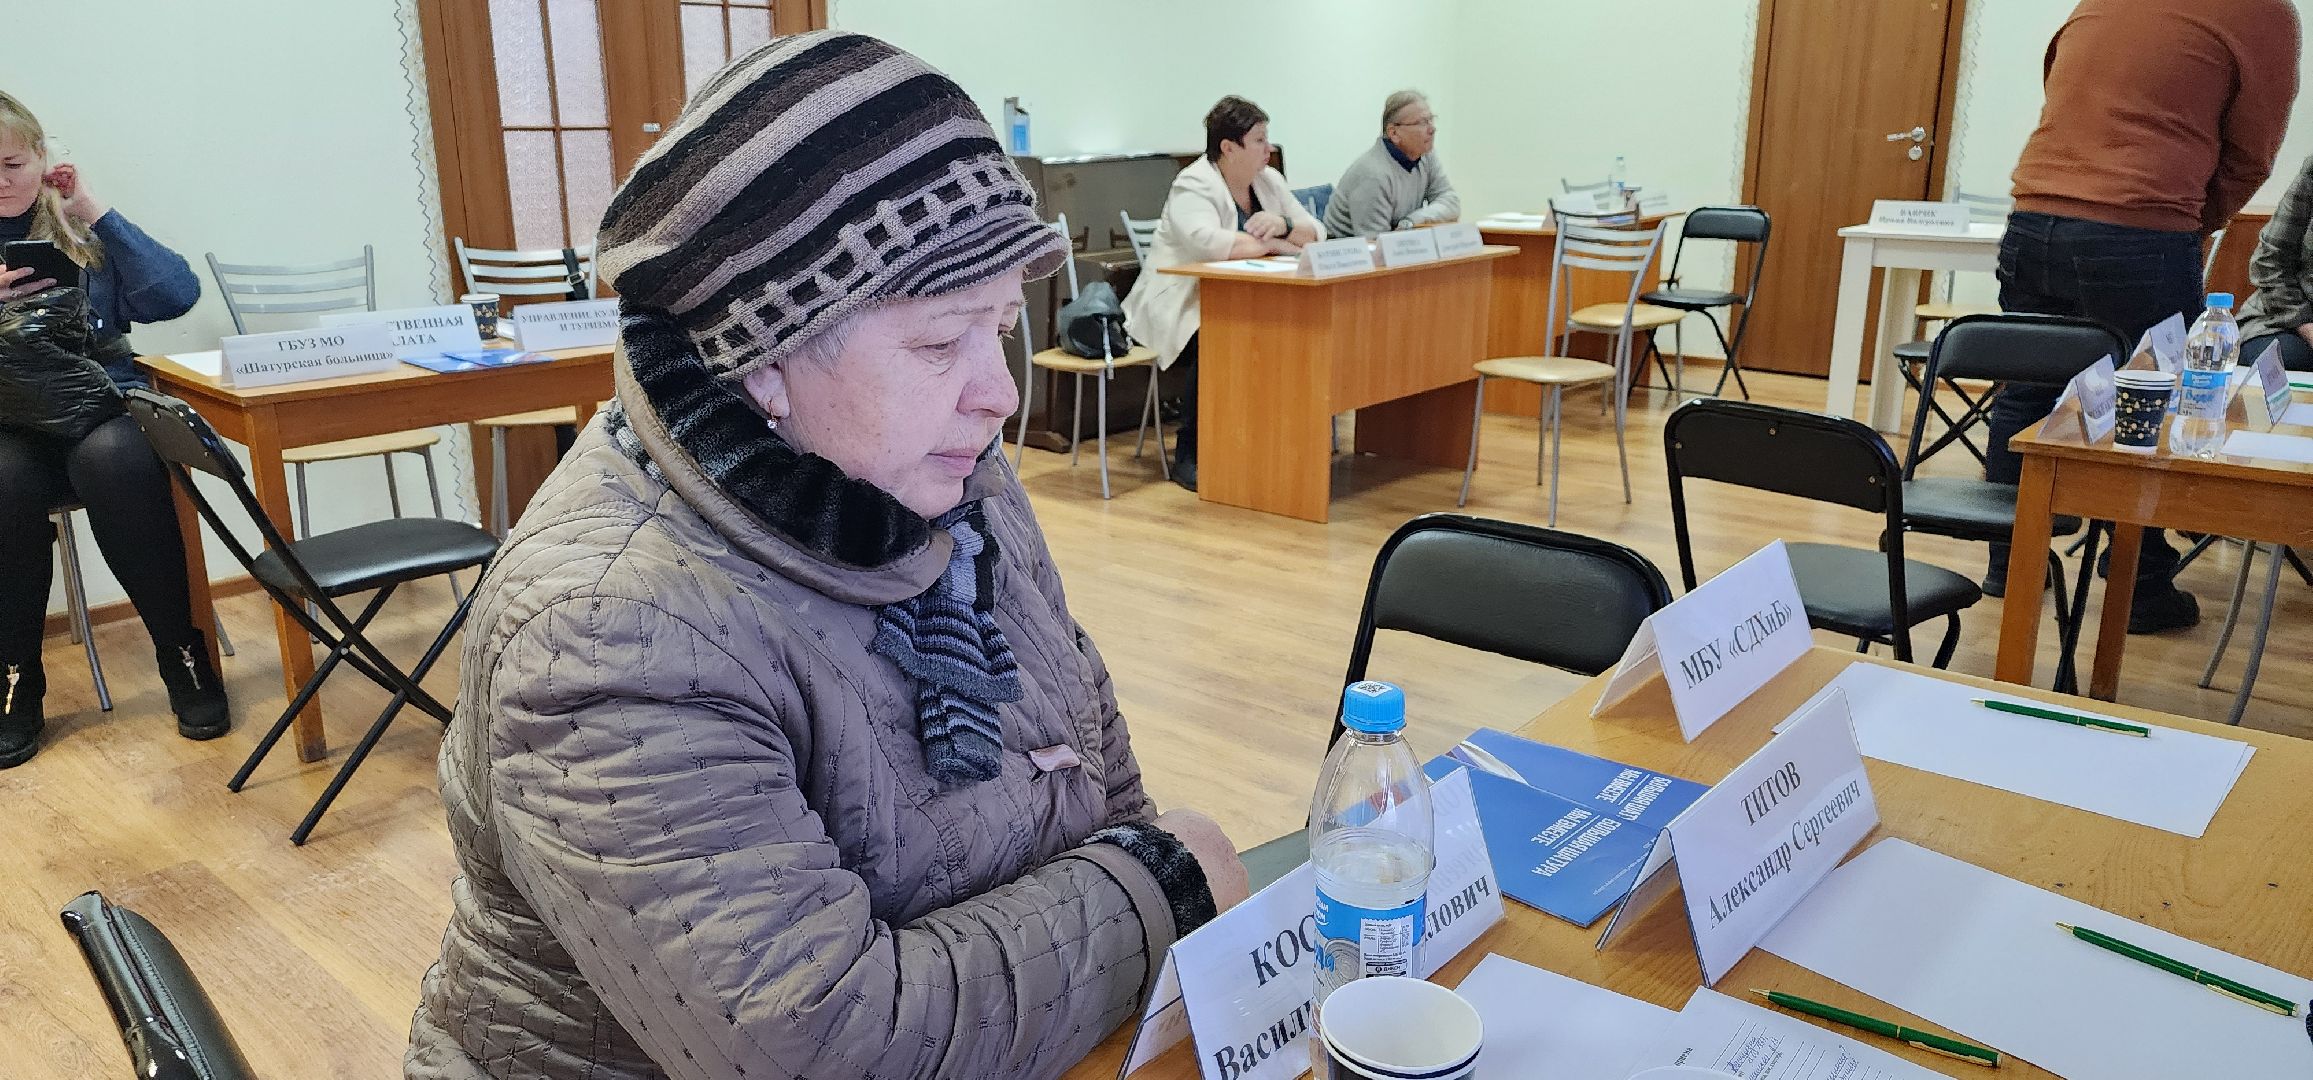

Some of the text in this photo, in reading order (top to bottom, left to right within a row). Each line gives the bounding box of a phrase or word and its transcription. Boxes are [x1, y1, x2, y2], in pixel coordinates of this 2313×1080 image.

[521, 311, 590, 324] УПРАВЛЕНИЕ
[572, 319, 619, 332] ТУРИЗМА
[277, 335, 345, 351] ГБУЗ МО
[236, 350, 394, 375] «Шатурская больница»
[1679, 599, 1793, 691] МБУ «СДХиБ»
[1740, 759, 1802, 828] ТИТОВ
[1568, 817, 1622, 854] БОЛЬШАЯ
[1530, 845, 1582, 877] ШАТУРА
[1707, 843, 1793, 930] Александр
[1792, 778, 1862, 854] Сергеевич
